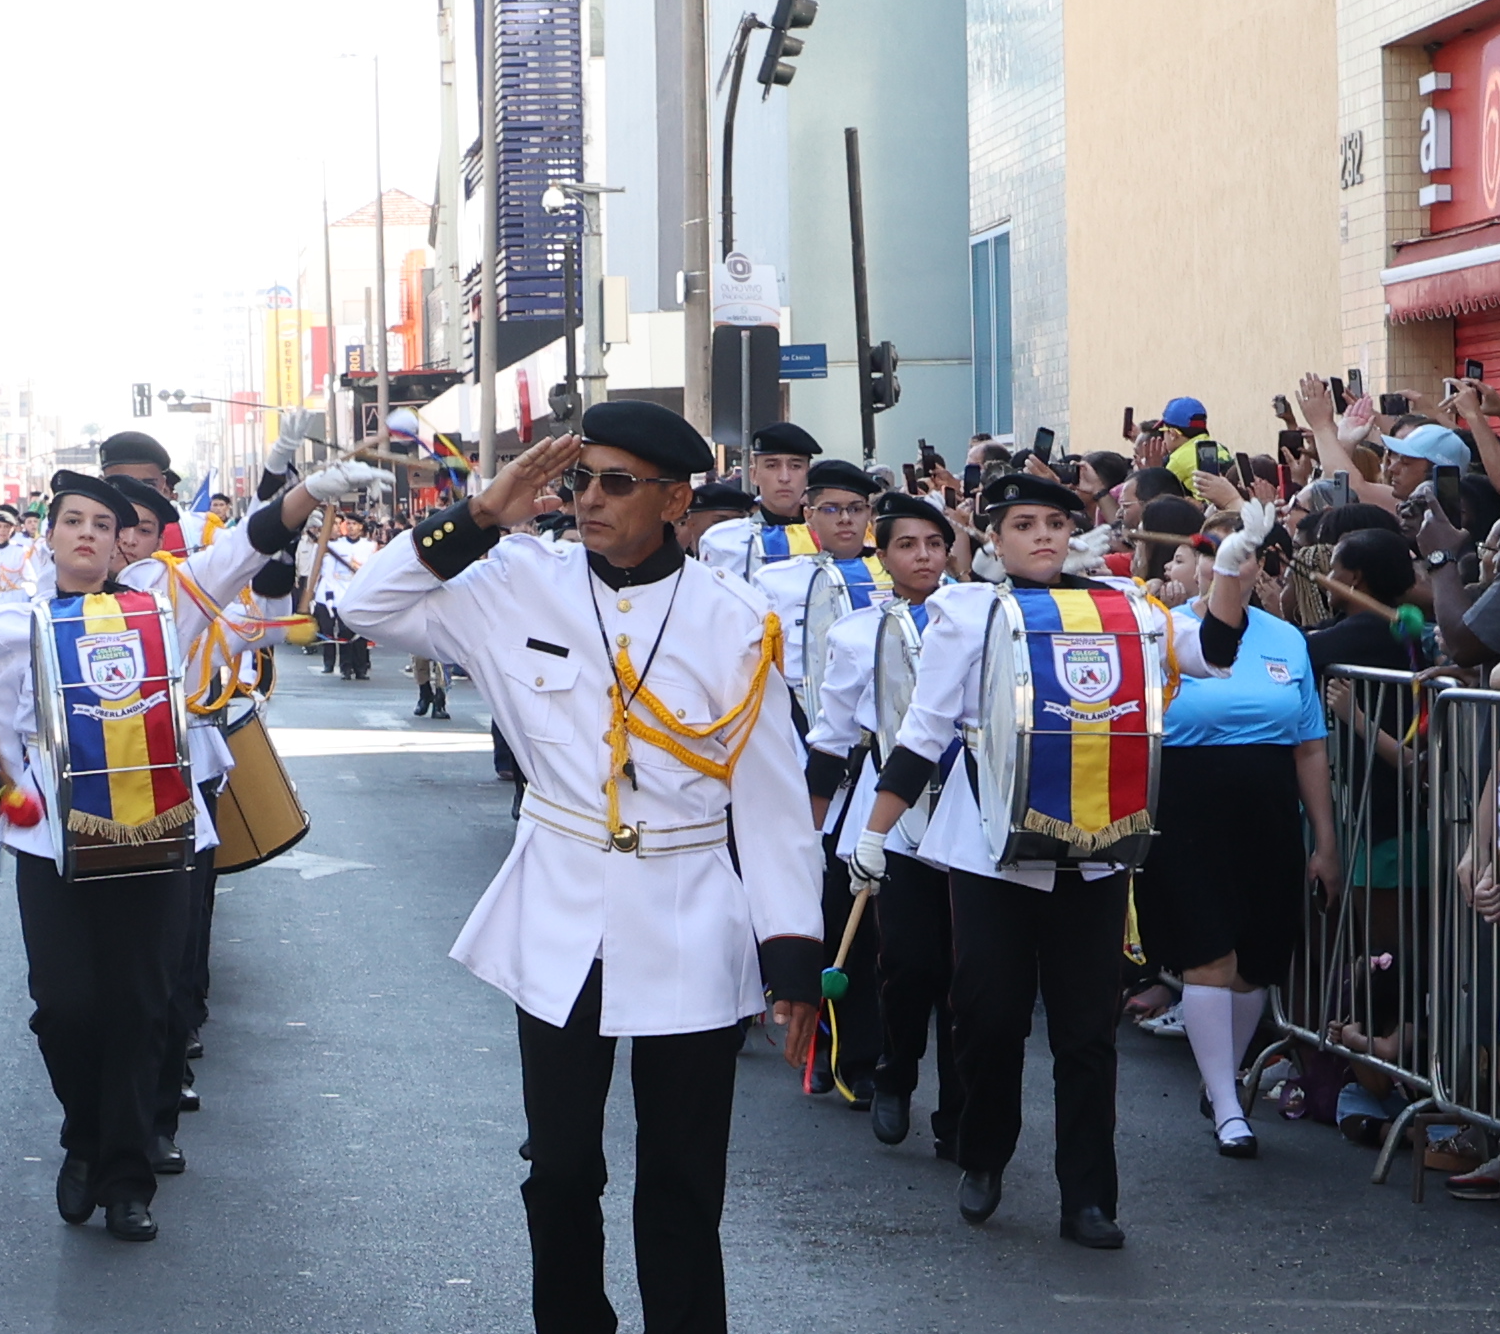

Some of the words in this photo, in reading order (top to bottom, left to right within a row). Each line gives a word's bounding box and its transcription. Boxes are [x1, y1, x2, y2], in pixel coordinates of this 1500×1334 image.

[1340, 130, 1364, 189] 252
[95, 702, 144, 718] UBERLÂNDIA
[1065, 708, 1117, 720] UBERLÂNDIA
